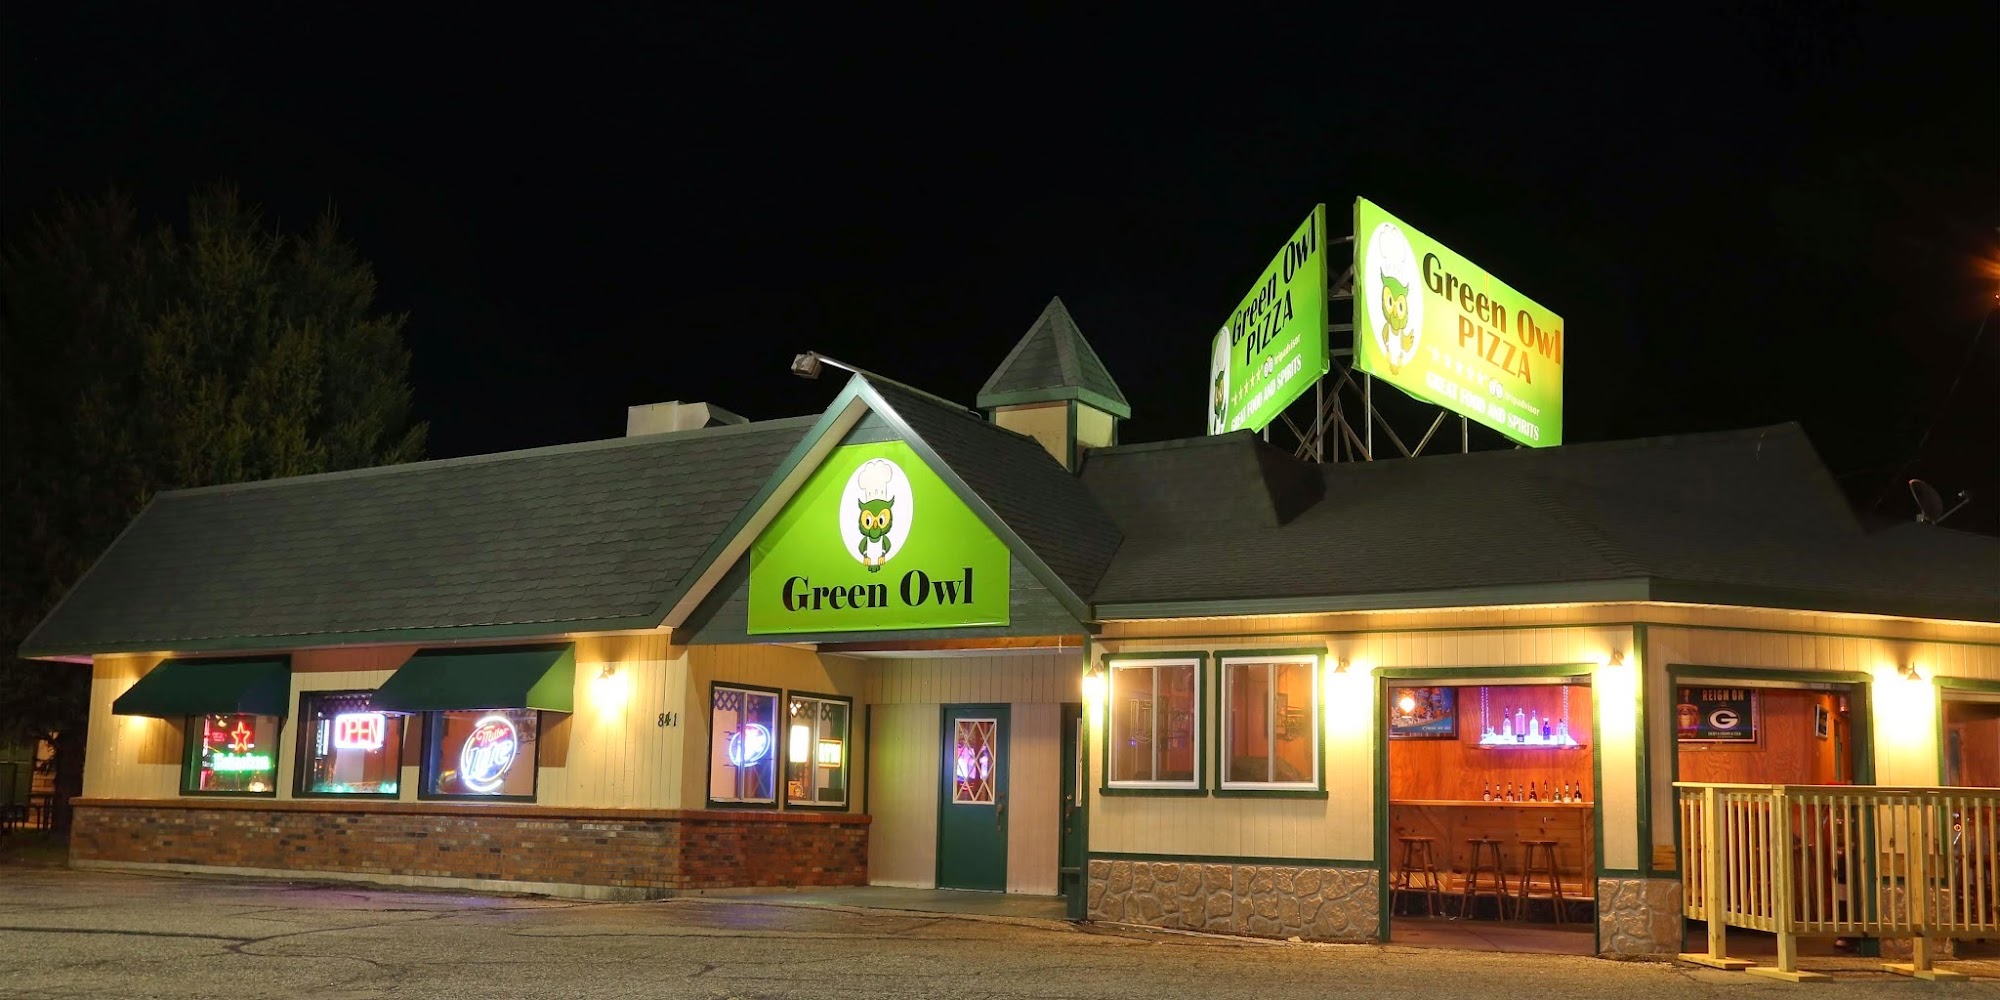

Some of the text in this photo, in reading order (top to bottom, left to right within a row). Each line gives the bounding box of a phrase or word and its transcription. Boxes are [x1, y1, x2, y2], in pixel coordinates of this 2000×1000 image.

[1232, 211, 1316, 347] Green Owl
[1423, 252, 1560, 365] Green Owl
[1247, 289, 1294, 366] PIZZA
[1459, 314, 1531, 385] PIZZA
[1276, 353, 1302, 390] SPIRITS
[1507, 412, 1539, 441] SPIRITS
[782, 567, 974, 612] Green Owl
[1702, 689, 1744, 701] REIGN ON
[337, 716, 381, 745] OPEN
[476, 725, 510, 746] Miller
[658, 711, 678, 727] 841
[1710, 709, 1738, 729] G
